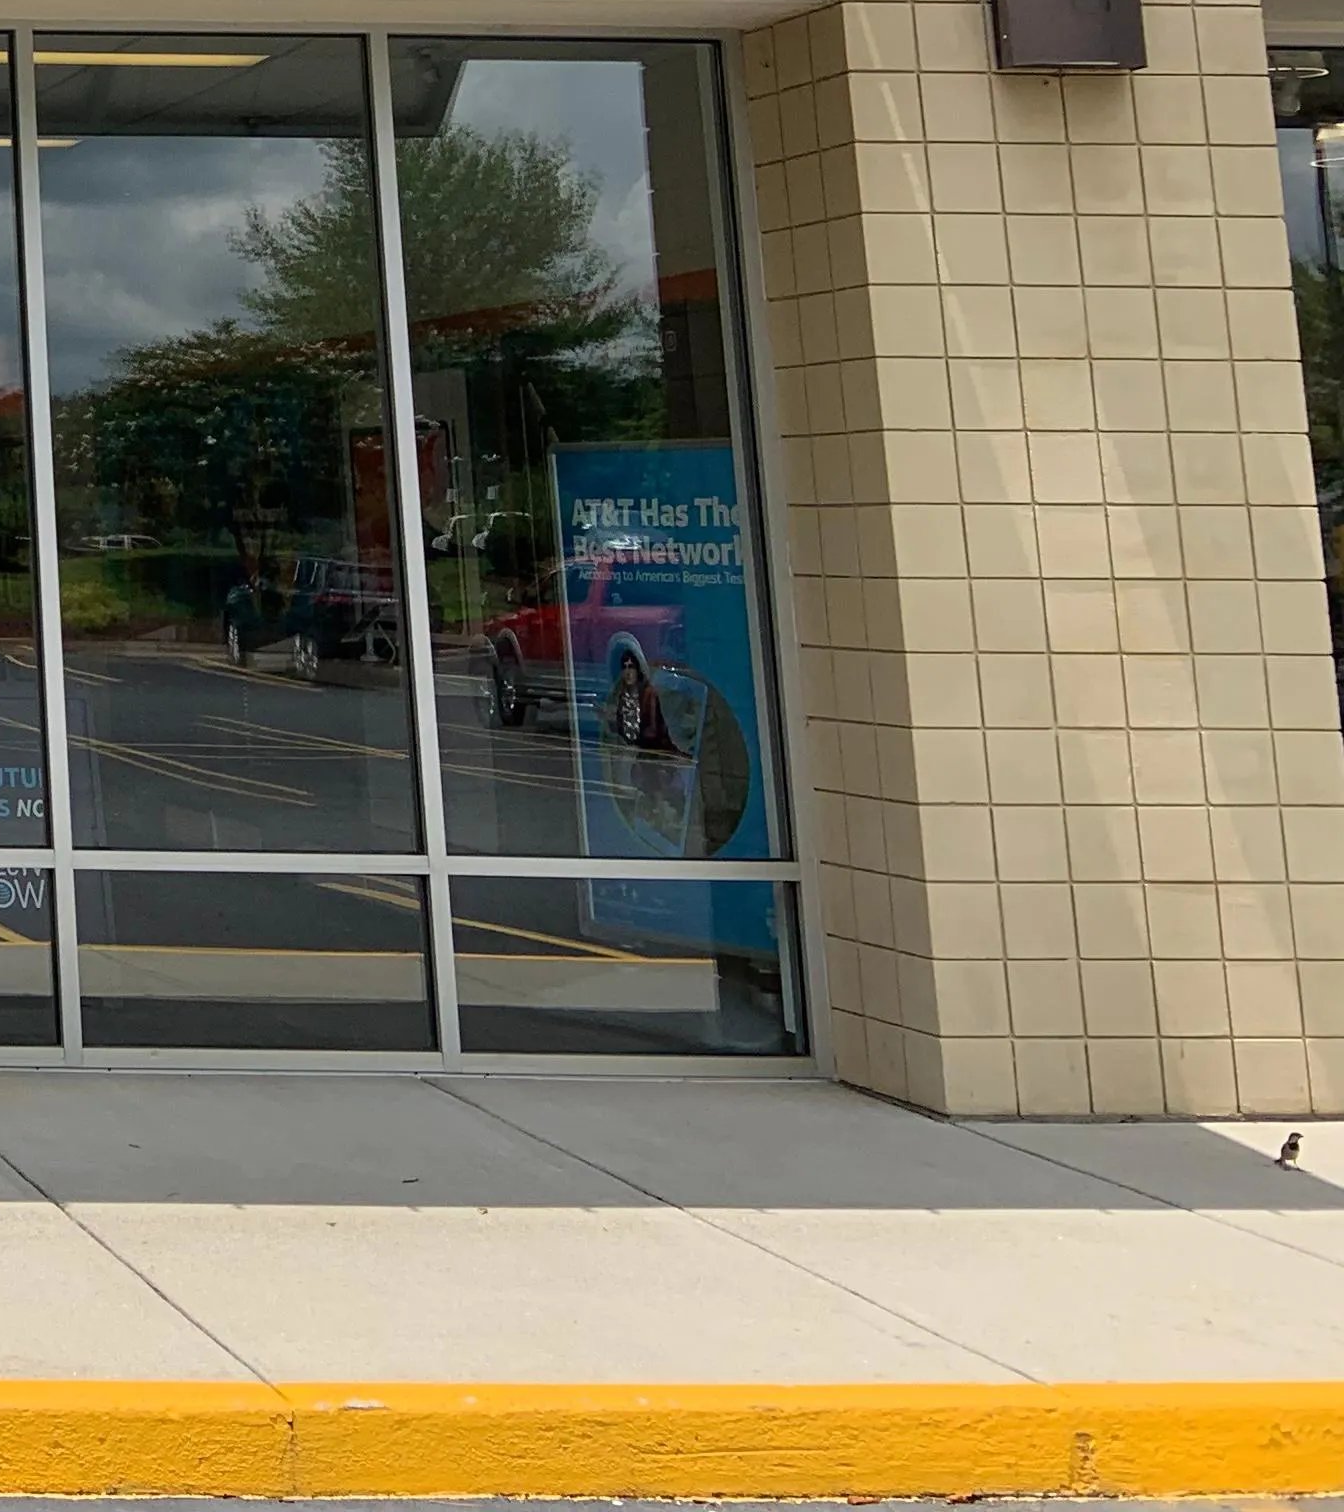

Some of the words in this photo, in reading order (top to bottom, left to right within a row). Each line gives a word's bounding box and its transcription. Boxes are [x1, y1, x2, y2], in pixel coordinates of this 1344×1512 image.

[572, 498, 634, 527] AT&T
[640, 498, 688, 527] Has
[623, 570, 633, 581] to
[683, 571, 722, 586] Biggest
